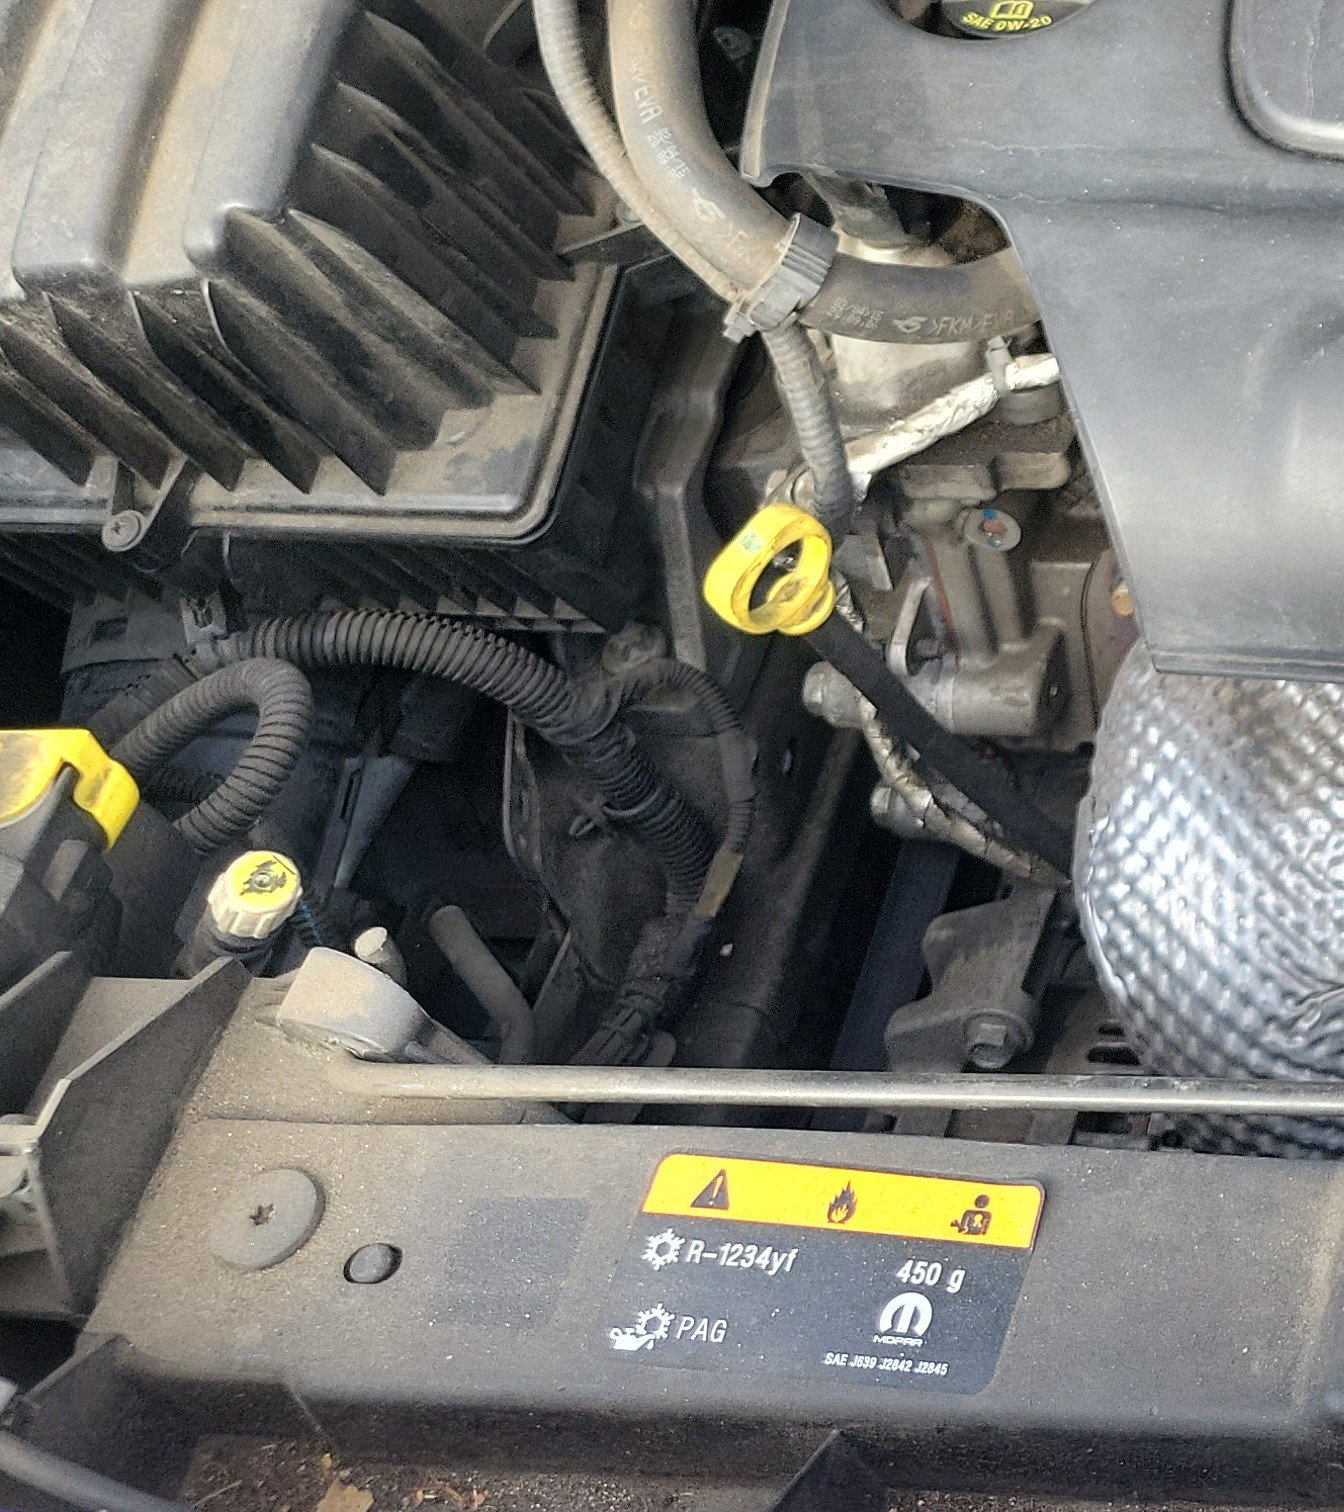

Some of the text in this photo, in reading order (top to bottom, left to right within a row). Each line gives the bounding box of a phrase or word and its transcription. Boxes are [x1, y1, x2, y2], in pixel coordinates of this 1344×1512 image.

[962, 12, 1053, 31] SAE 0W-20
[686, 1239, 800, 1275] R-1234yf
[896, 1259, 967, 1294] 450 g
[675, 1316, 729, 1344] PAG
[872, 1333, 925, 1348] MOPAR
[823, 1351, 949, 1377] SAE J639 J2842 J2845
